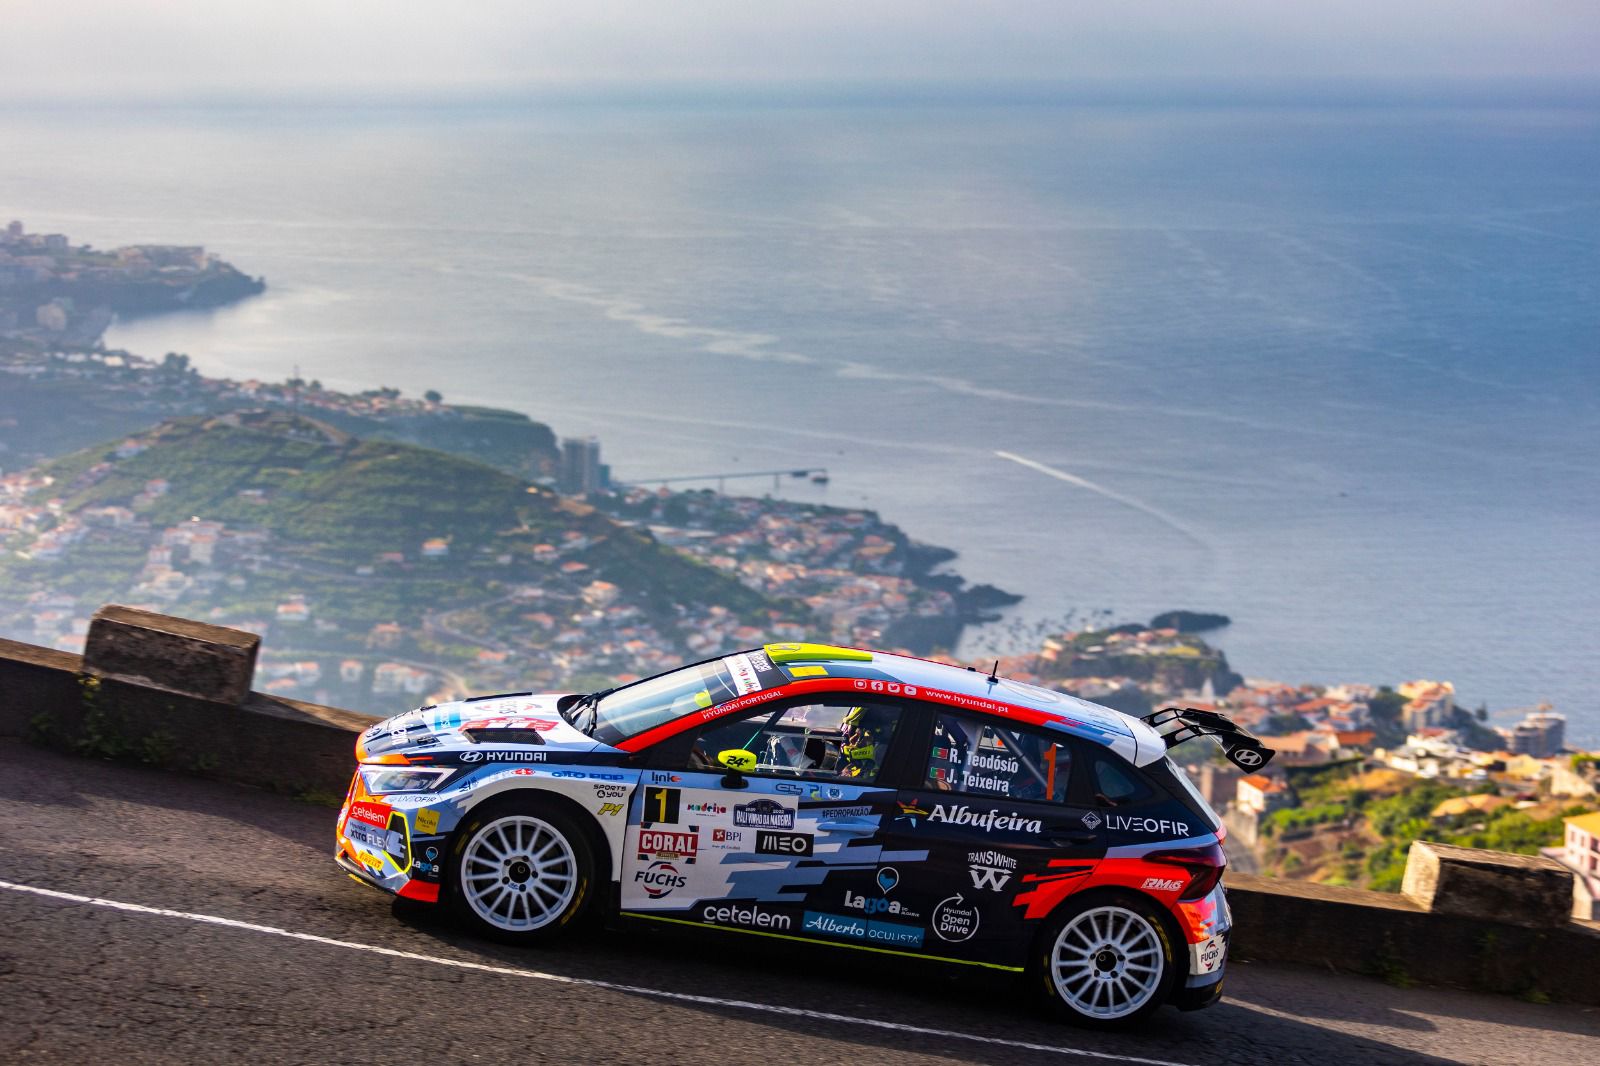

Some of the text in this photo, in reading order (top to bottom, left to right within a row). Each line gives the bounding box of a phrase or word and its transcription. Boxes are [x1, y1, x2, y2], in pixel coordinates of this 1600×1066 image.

[703, 702, 740, 719] HYUNDAI
[740, 690, 784, 707] PORTUGAL
[925, 689, 1009, 713] www.hyundai.pt
[486, 752, 547, 761] HYUNDAI
[949, 747, 1019, 774] R. Teodósio
[946, 768, 1010, 793] J. Teixeira
[1043, 742, 1057, 800] 1
[655, 788, 667, 823] 1
[352, 806, 386, 825] cetelem
[748, 812, 763, 825] VINHO
[763, 814, 770, 826] DA
[770, 814, 792, 827] MADEIRA
[927, 804, 1042, 834] Albufeira
[1106, 814, 1189, 837] LIVEOFIR
[641, 833, 696, 853] CORAL
[725, 831, 742, 841] BPI
[763, 835, 807, 852] MEO
[412, 857, 439, 873] Lagoa
[967, 850, 1017, 869] TRANSWHITE
[634, 871, 687, 888] FUCHS
[844, 890, 901, 914] Lagoa
[943, 906, 972, 916] Hyundai
[703, 905, 791, 929] cetelem
[941, 914, 970, 926] Open
[806, 915, 919, 944] Alberto OCULISTA
[940, 922, 969, 935] Drive
[1200, 948, 1220, 963] FUCHS
